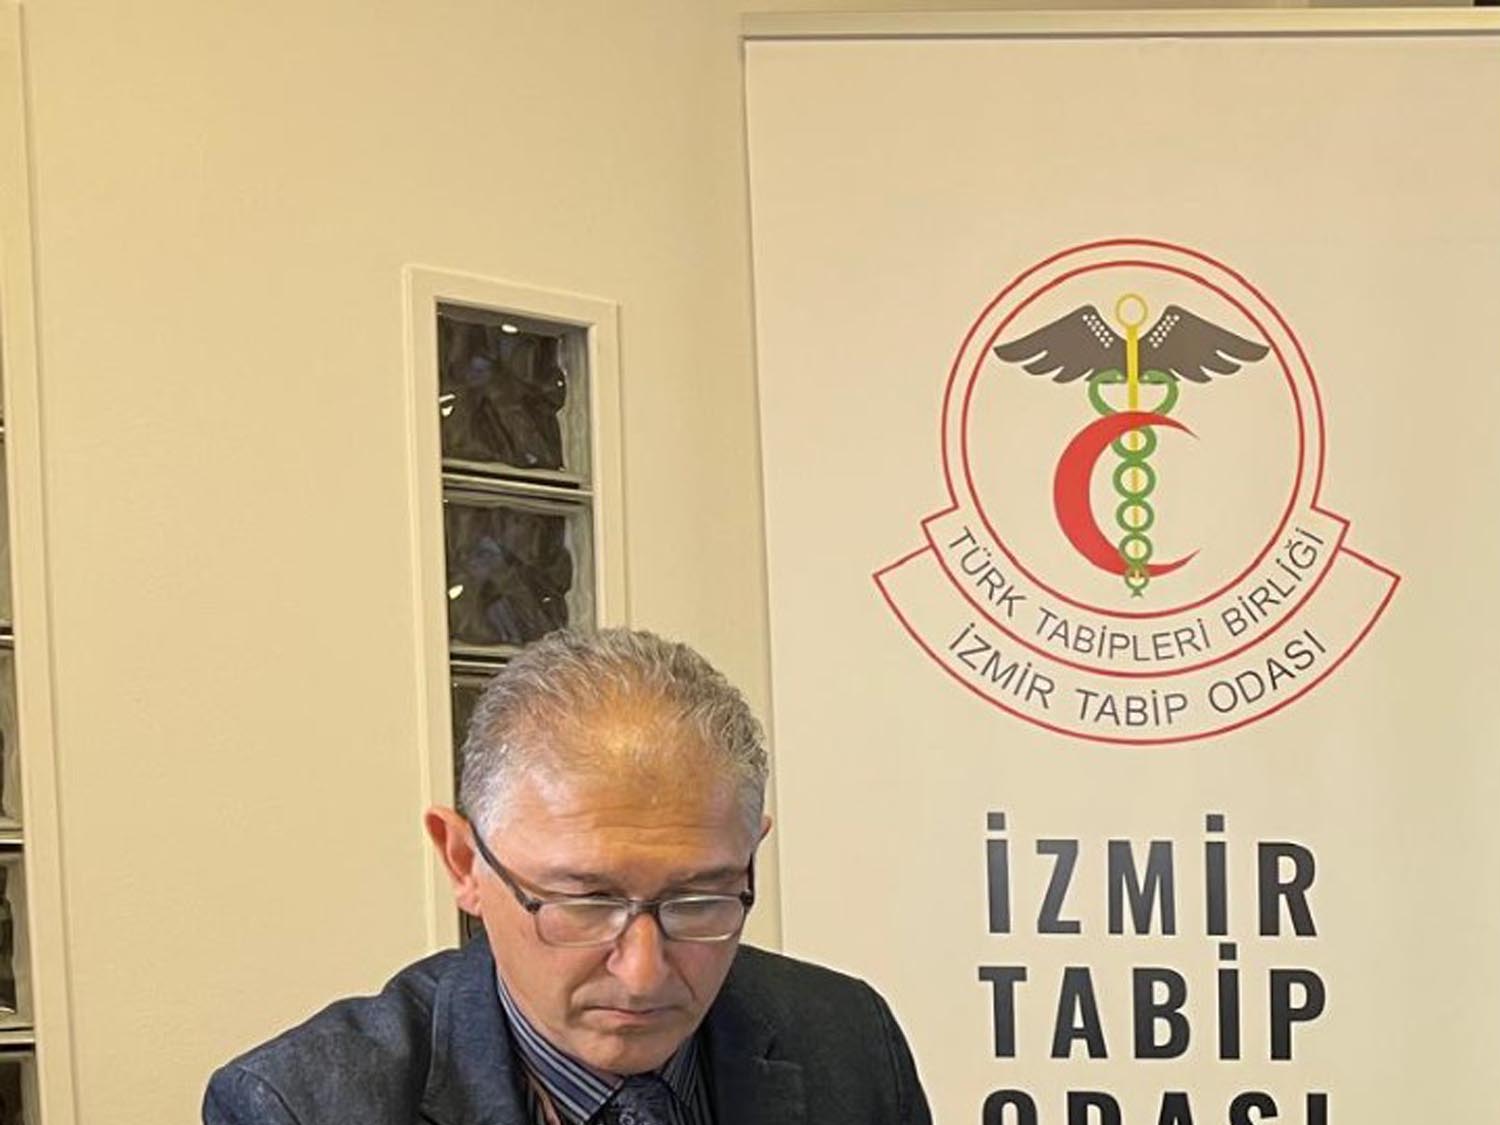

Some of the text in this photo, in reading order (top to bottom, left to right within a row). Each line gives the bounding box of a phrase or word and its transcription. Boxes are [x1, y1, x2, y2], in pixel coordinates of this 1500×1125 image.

[948, 527, 1325, 662] TÜRK TABİPLERİ BİRLİĞİ
[948, 622, 1327, 726] İZMİR TABİP ODASI
[986, 811, 1317, 937] İZMİR
[977, 942, 1327, 1061] TABİP
